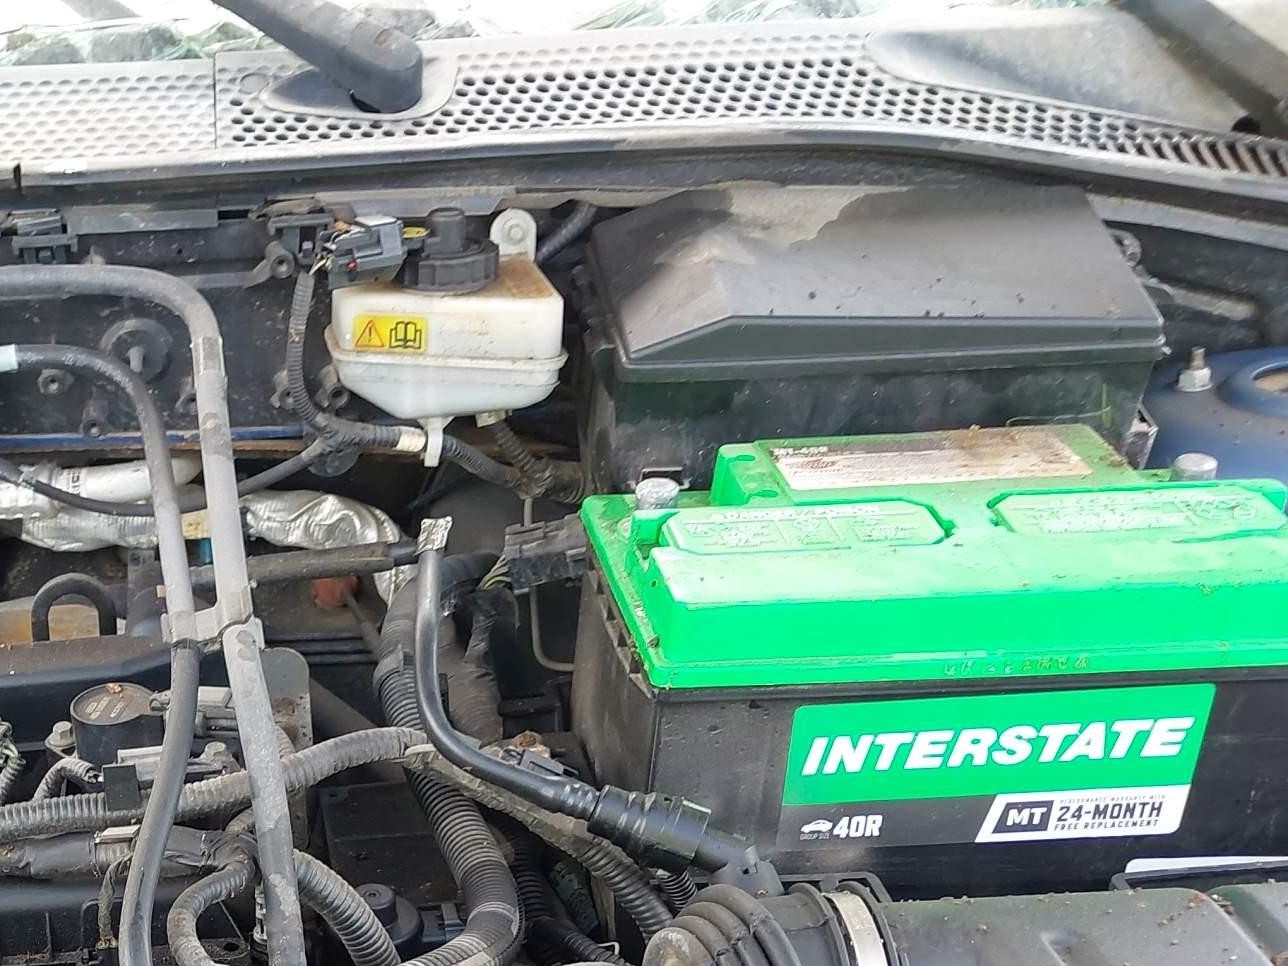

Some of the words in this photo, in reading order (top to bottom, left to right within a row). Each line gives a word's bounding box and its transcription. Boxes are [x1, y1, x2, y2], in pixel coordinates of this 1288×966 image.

[800, 716, 1196, 776] INTERSTATE
[1005, 806, 1049, 827] MT
[1055, 801, 1164, 823] 24-MONTH
[832, 815, 883, 838] 40R
[1054, 823, 1080, 831] FREE
[1083, 819, 1159, 829] REPLACEMENT
